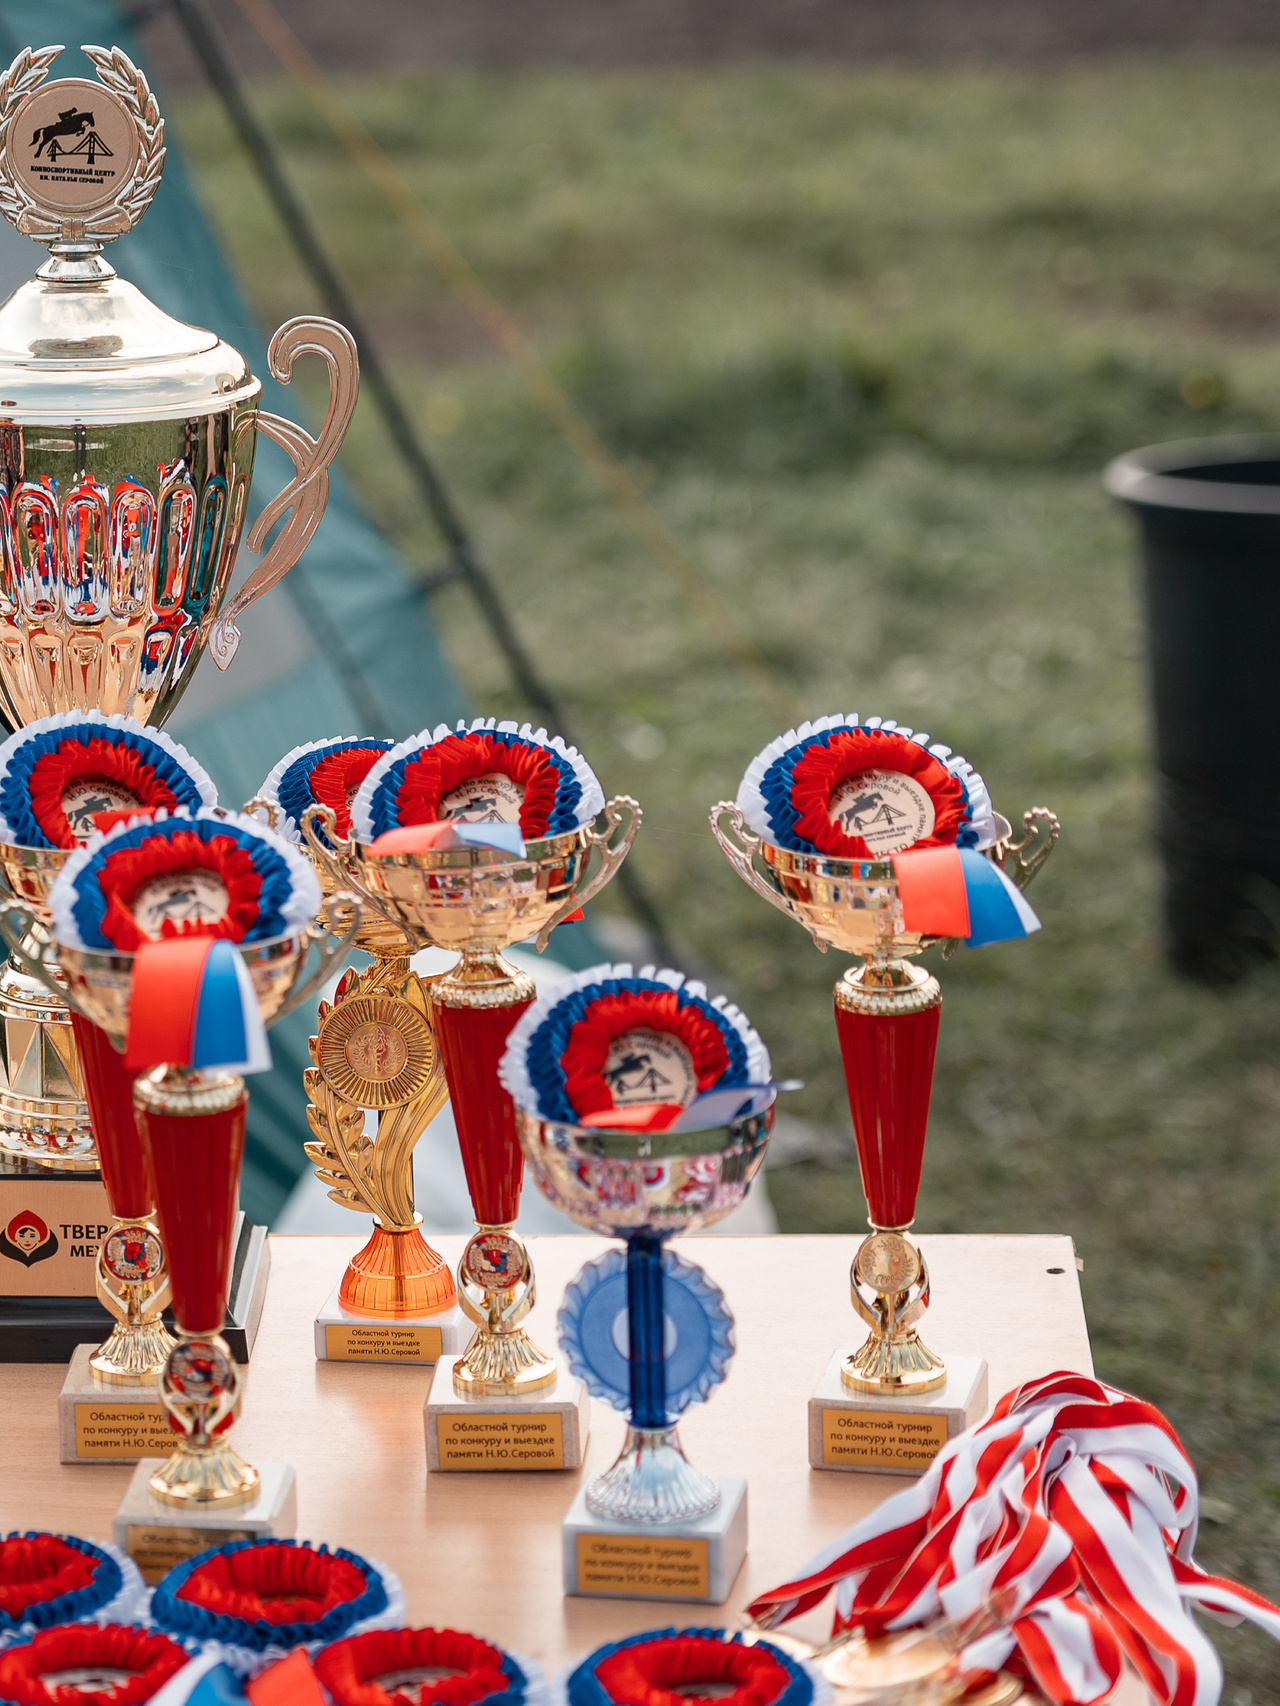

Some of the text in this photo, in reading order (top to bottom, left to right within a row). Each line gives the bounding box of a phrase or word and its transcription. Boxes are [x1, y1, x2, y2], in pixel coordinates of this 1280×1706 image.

[31, 165, 92, 176] КОННОСПОРТИВНЫЙ
[478, 779, 513, 791] конкуру
[900, 782, 925, 812] выездке
[59, 1224, 114, 1239] ТВЕР
[352, 1329, 389, 1337] Областной
[374, 1348, 420, 1356] Н.Ю.Серовой
[90, 1412, 145, 1421] Областной
[452, 1422, 547, 1434] Областной турнир
[838, 1418, 932, 1434] Областной турнир
[98, 1427, 138, 1437] конкуру
[123, 1439, 178, 1449] Н.Ю.Серов
[461, 1438, 502, 1447] конкуру
[846, 1434, 887, 1445] конкуру
[898, 1437, 940, 1446] выездке
[486, 1449, 555, 1460] Н.Ю.Серовой
[832, 1447, 867, 1455] памяти
